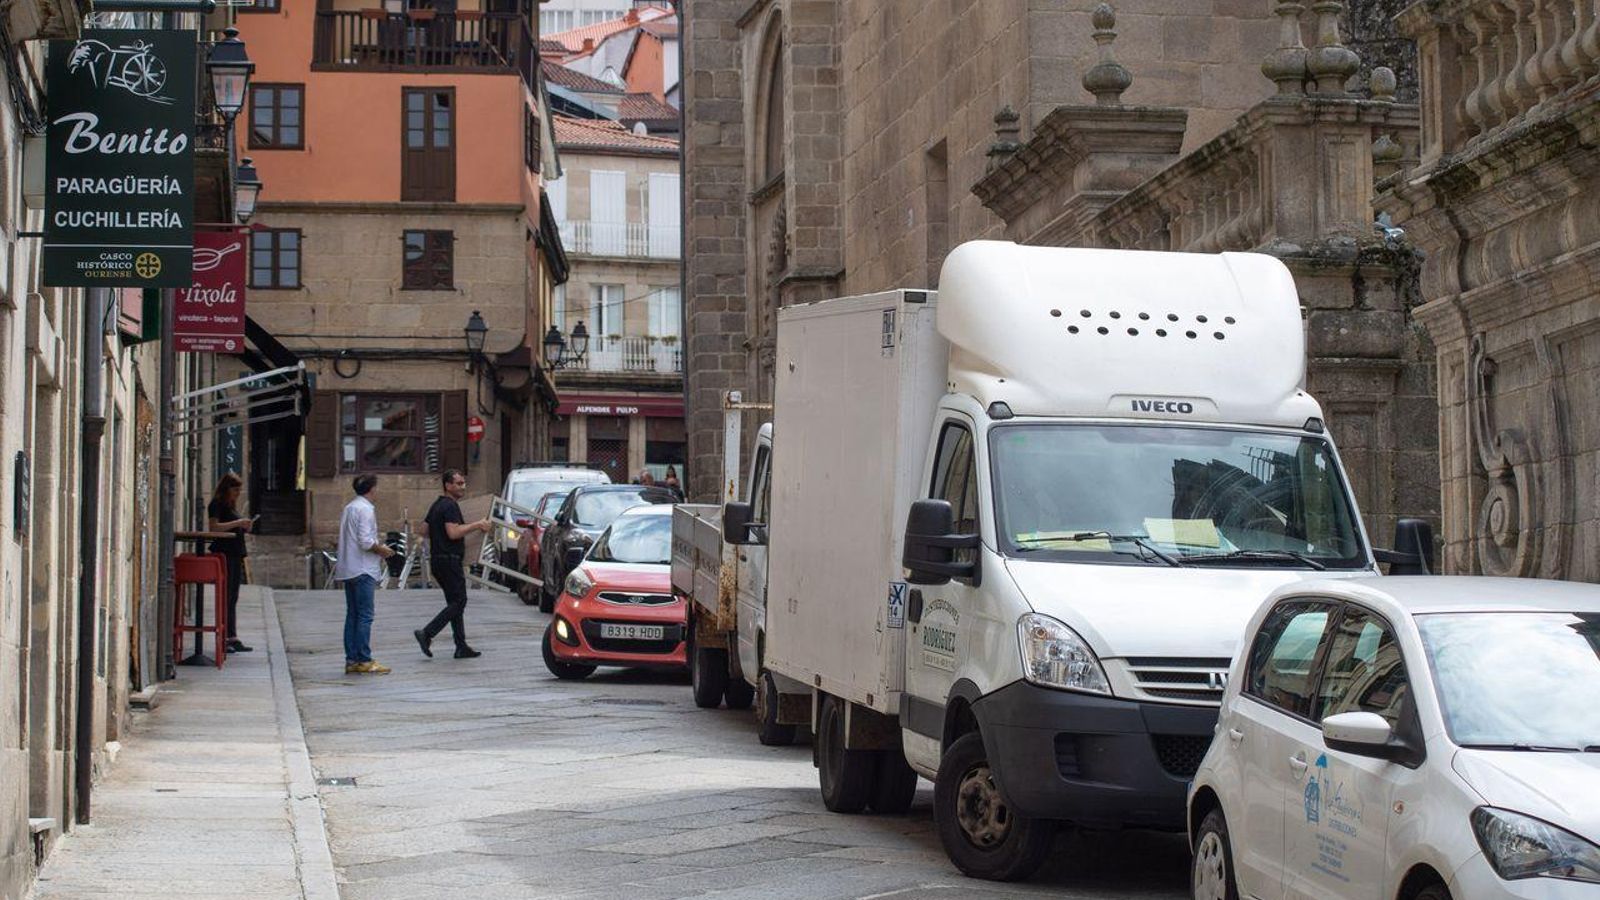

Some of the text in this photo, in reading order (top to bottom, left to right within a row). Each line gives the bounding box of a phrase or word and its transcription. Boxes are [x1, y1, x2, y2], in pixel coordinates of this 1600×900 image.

[53, 112, 188, 155] Benito
[56, 175, 182, 194] PARAGÜERÍA
[55, 208, 183, 228] CUCHILLERÍA
[99, 252, 132, 260] CASCO
[76, 260, 133, 269] HISTÓRICO
[84, 270, 132, 278] OURENSE
[576, 405, 639, 414] ALPENDRE PULPO
[1131, 399, 1193, 414] IVECO
[607, 625, 661, 639] 8319 HDD
